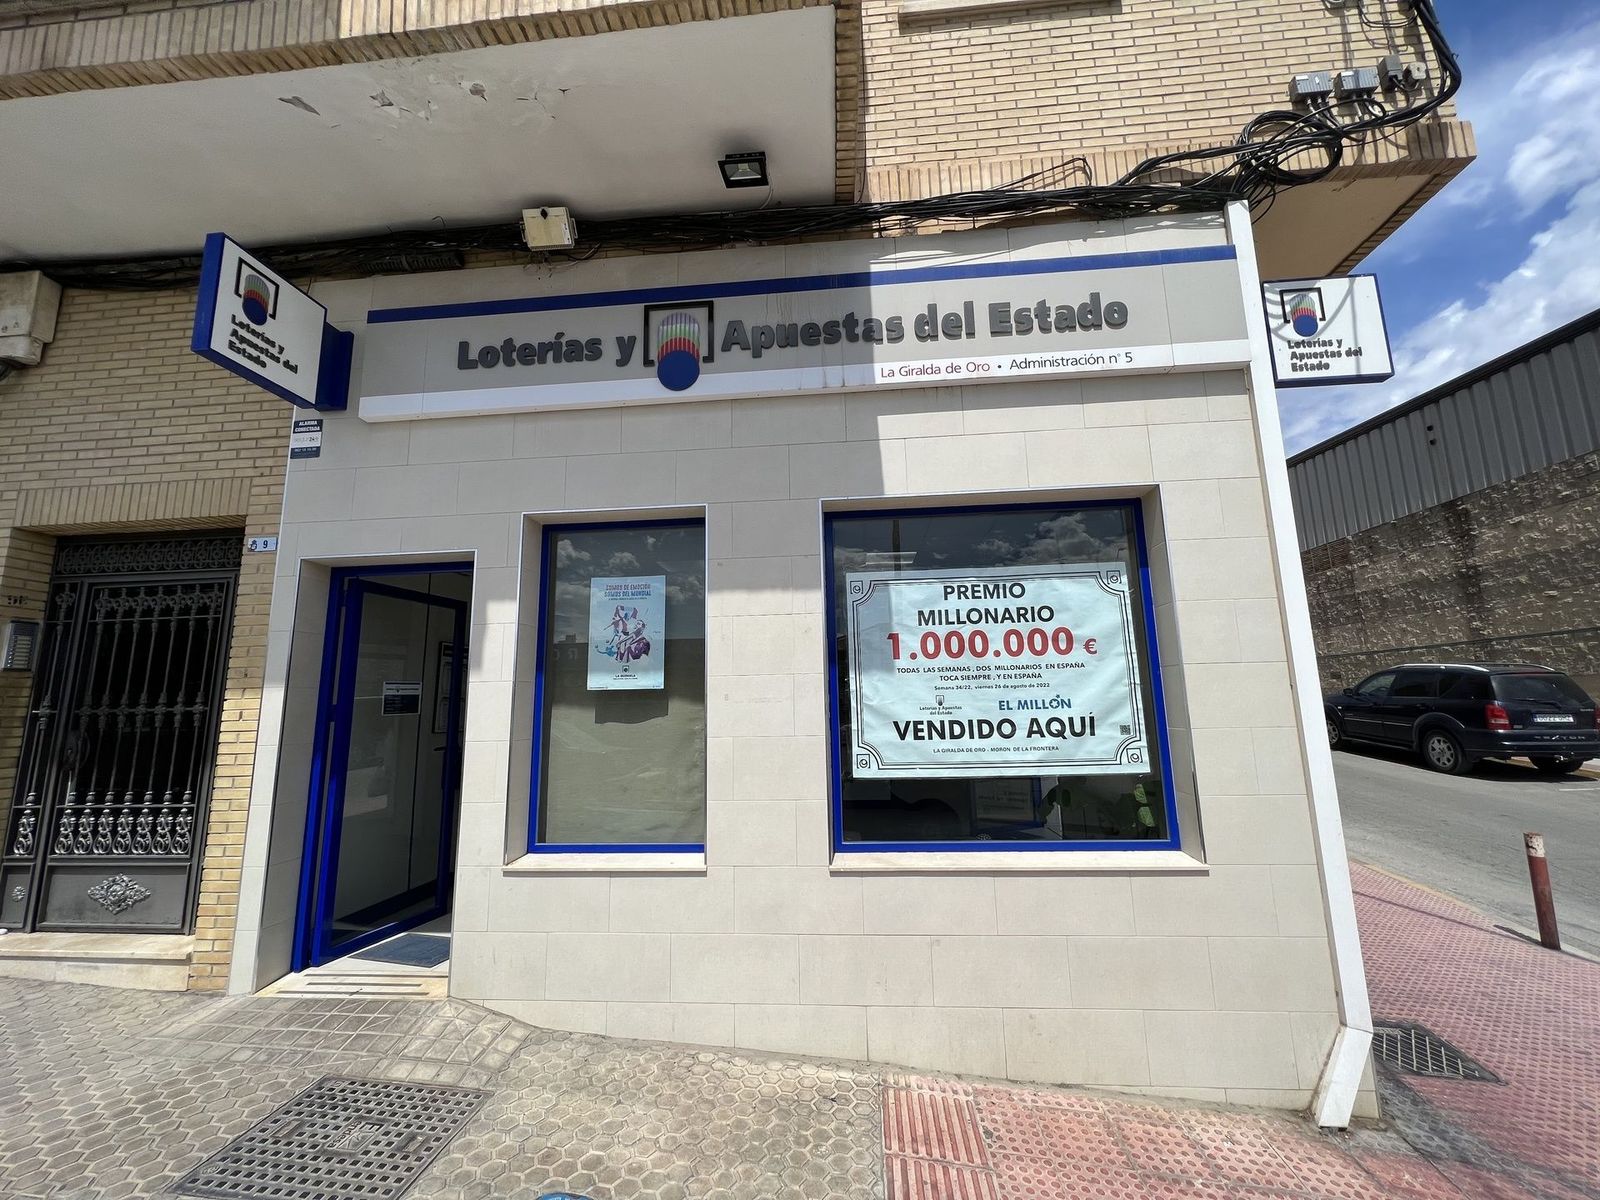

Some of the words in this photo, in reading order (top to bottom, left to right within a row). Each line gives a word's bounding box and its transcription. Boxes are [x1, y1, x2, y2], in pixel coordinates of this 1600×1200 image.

[458, 332, 602, 370] Loterías
[616, 336, 636, 367] y
[721, 312, 905, 358] Apuestas
[913, 300, 975, 342] del
[988, 292, 1129, 338] Estado
[230, 328, 280, 363] Apuestas
[283, 360, 298, 374] del
[278, 344, 284, 354] y
[1287, 338, 1333, 349] Loterías
[1336, 338, 1342, 347] y
[228, 340, 266, 368] Estado
[1290, 350, 1342, 362] Apuestas
[1345, 347, 1362, 356] del
[881, 368, 895, 378] La
[899, 362, 941, 377] Giralda
[945, 362, 962, 374] de
[966, 361, 990, 373] Oro
[1009, 354, 1105, 370] Administración
[1125, 352, 1133, 364] 5
[1291, 361, 1330, 372] Estado
[263, 540, 268, 549] 9
[943, 582, 1026, 600] PREMIO
[918, 605, 1055, 626] MILLONARIO
[887, 627, 1074, 660] 1.000.000
[1083, 638, 1097, 654] €
[999, 700, 1013, 710] EL
[1017, 694, 1072, 710] MILLÓN
[892, 718, 1017, 740] VENDIDO
[1026, 712, 1096, 740] AQUÍ
